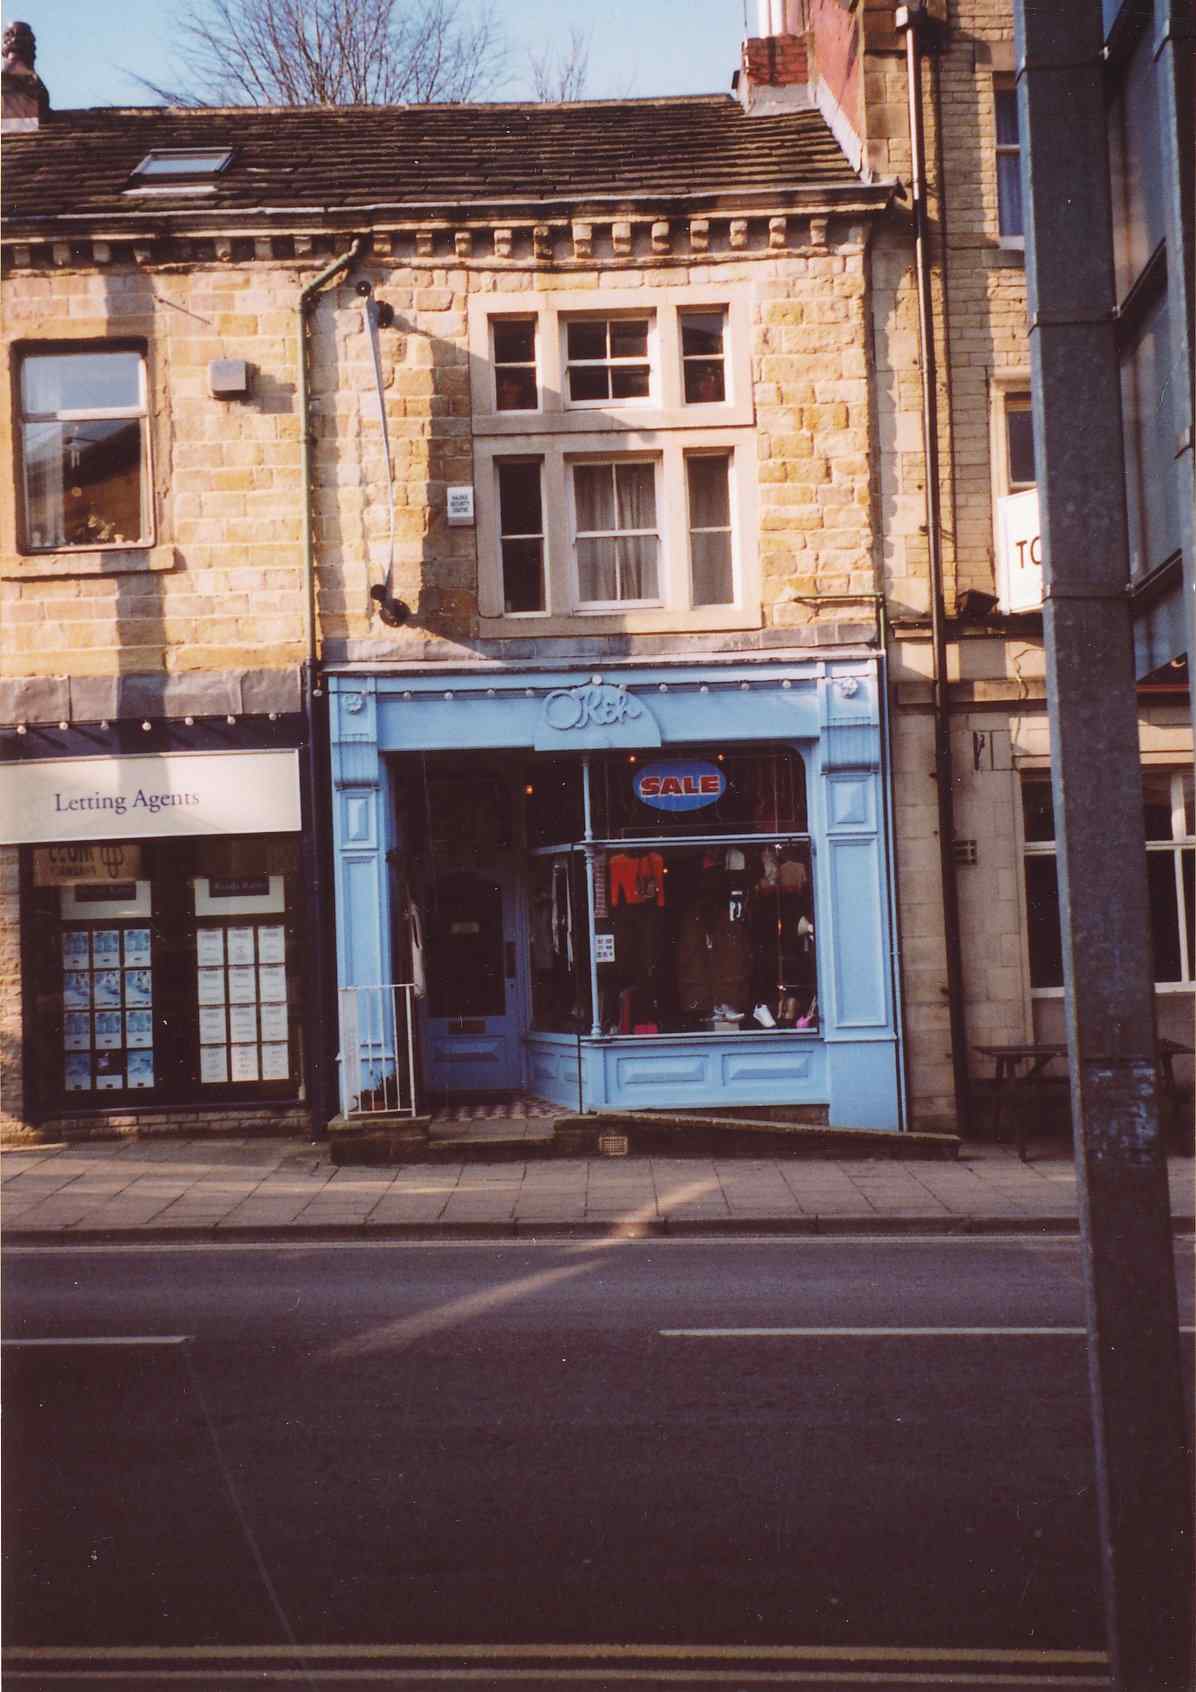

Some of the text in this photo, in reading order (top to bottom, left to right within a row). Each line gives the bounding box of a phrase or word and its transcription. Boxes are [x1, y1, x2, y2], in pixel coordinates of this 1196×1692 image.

[639, 775, 721, 797] SALE
[55, 788, 200, 816] Letting Agents
